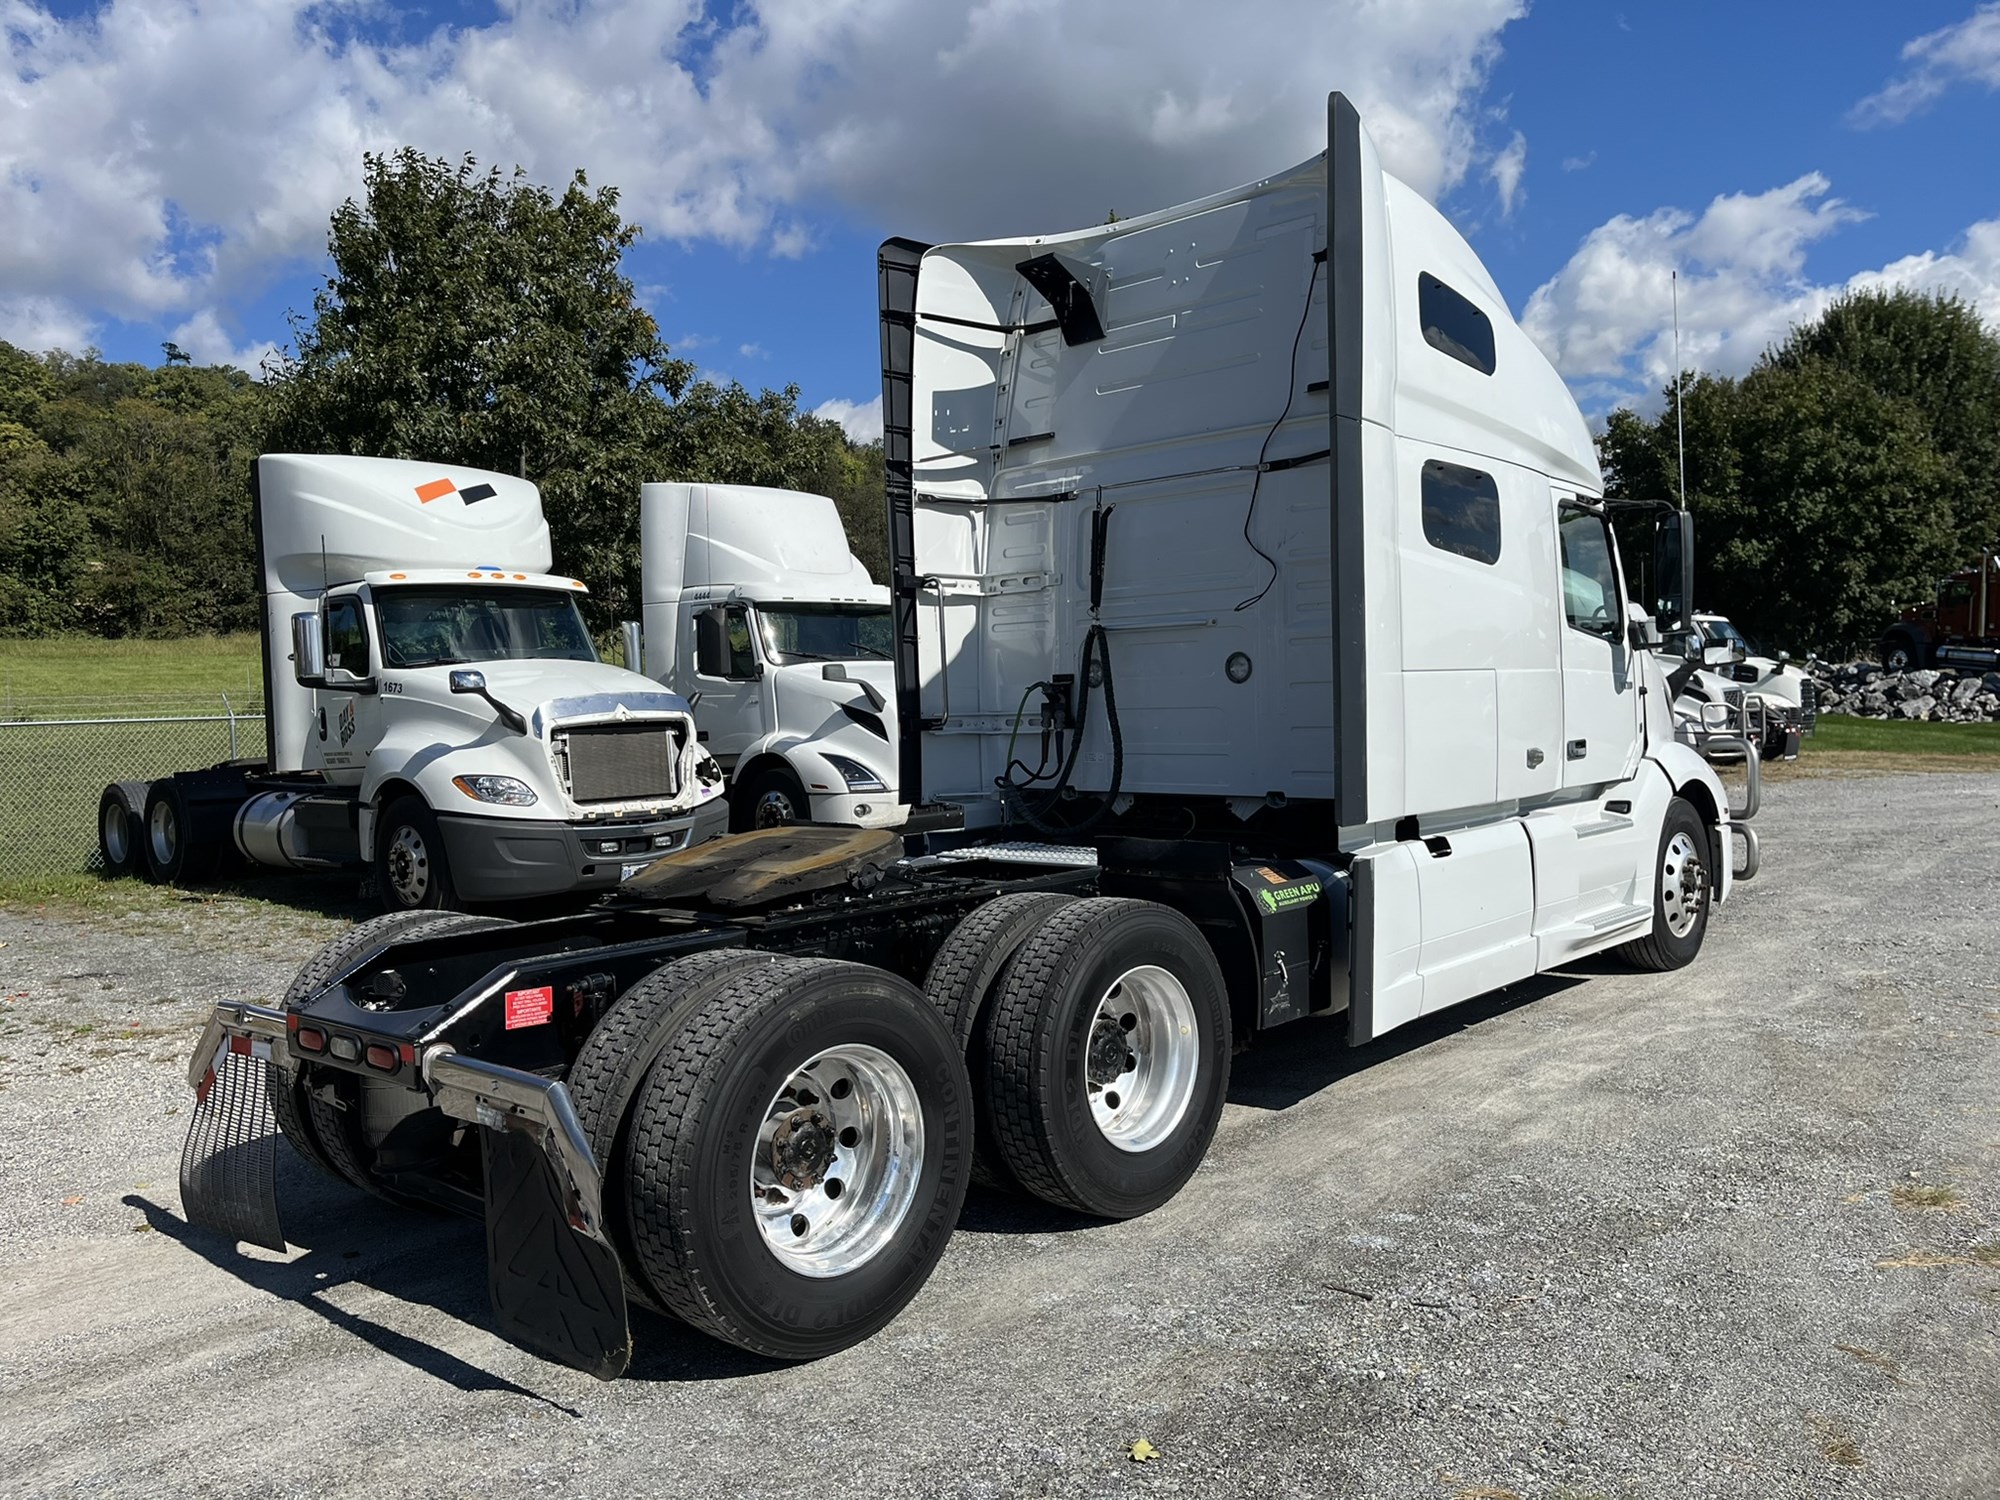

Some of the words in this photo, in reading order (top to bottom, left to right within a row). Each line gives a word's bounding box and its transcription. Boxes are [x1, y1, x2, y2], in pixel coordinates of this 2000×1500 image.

[384, 681, 403, 693] 1673
[1273, 887, 1301, 900] GREEN
[1300, 882, 1320, 895] APU
[903, 1062, 961, 1277] CONTINENTAL
